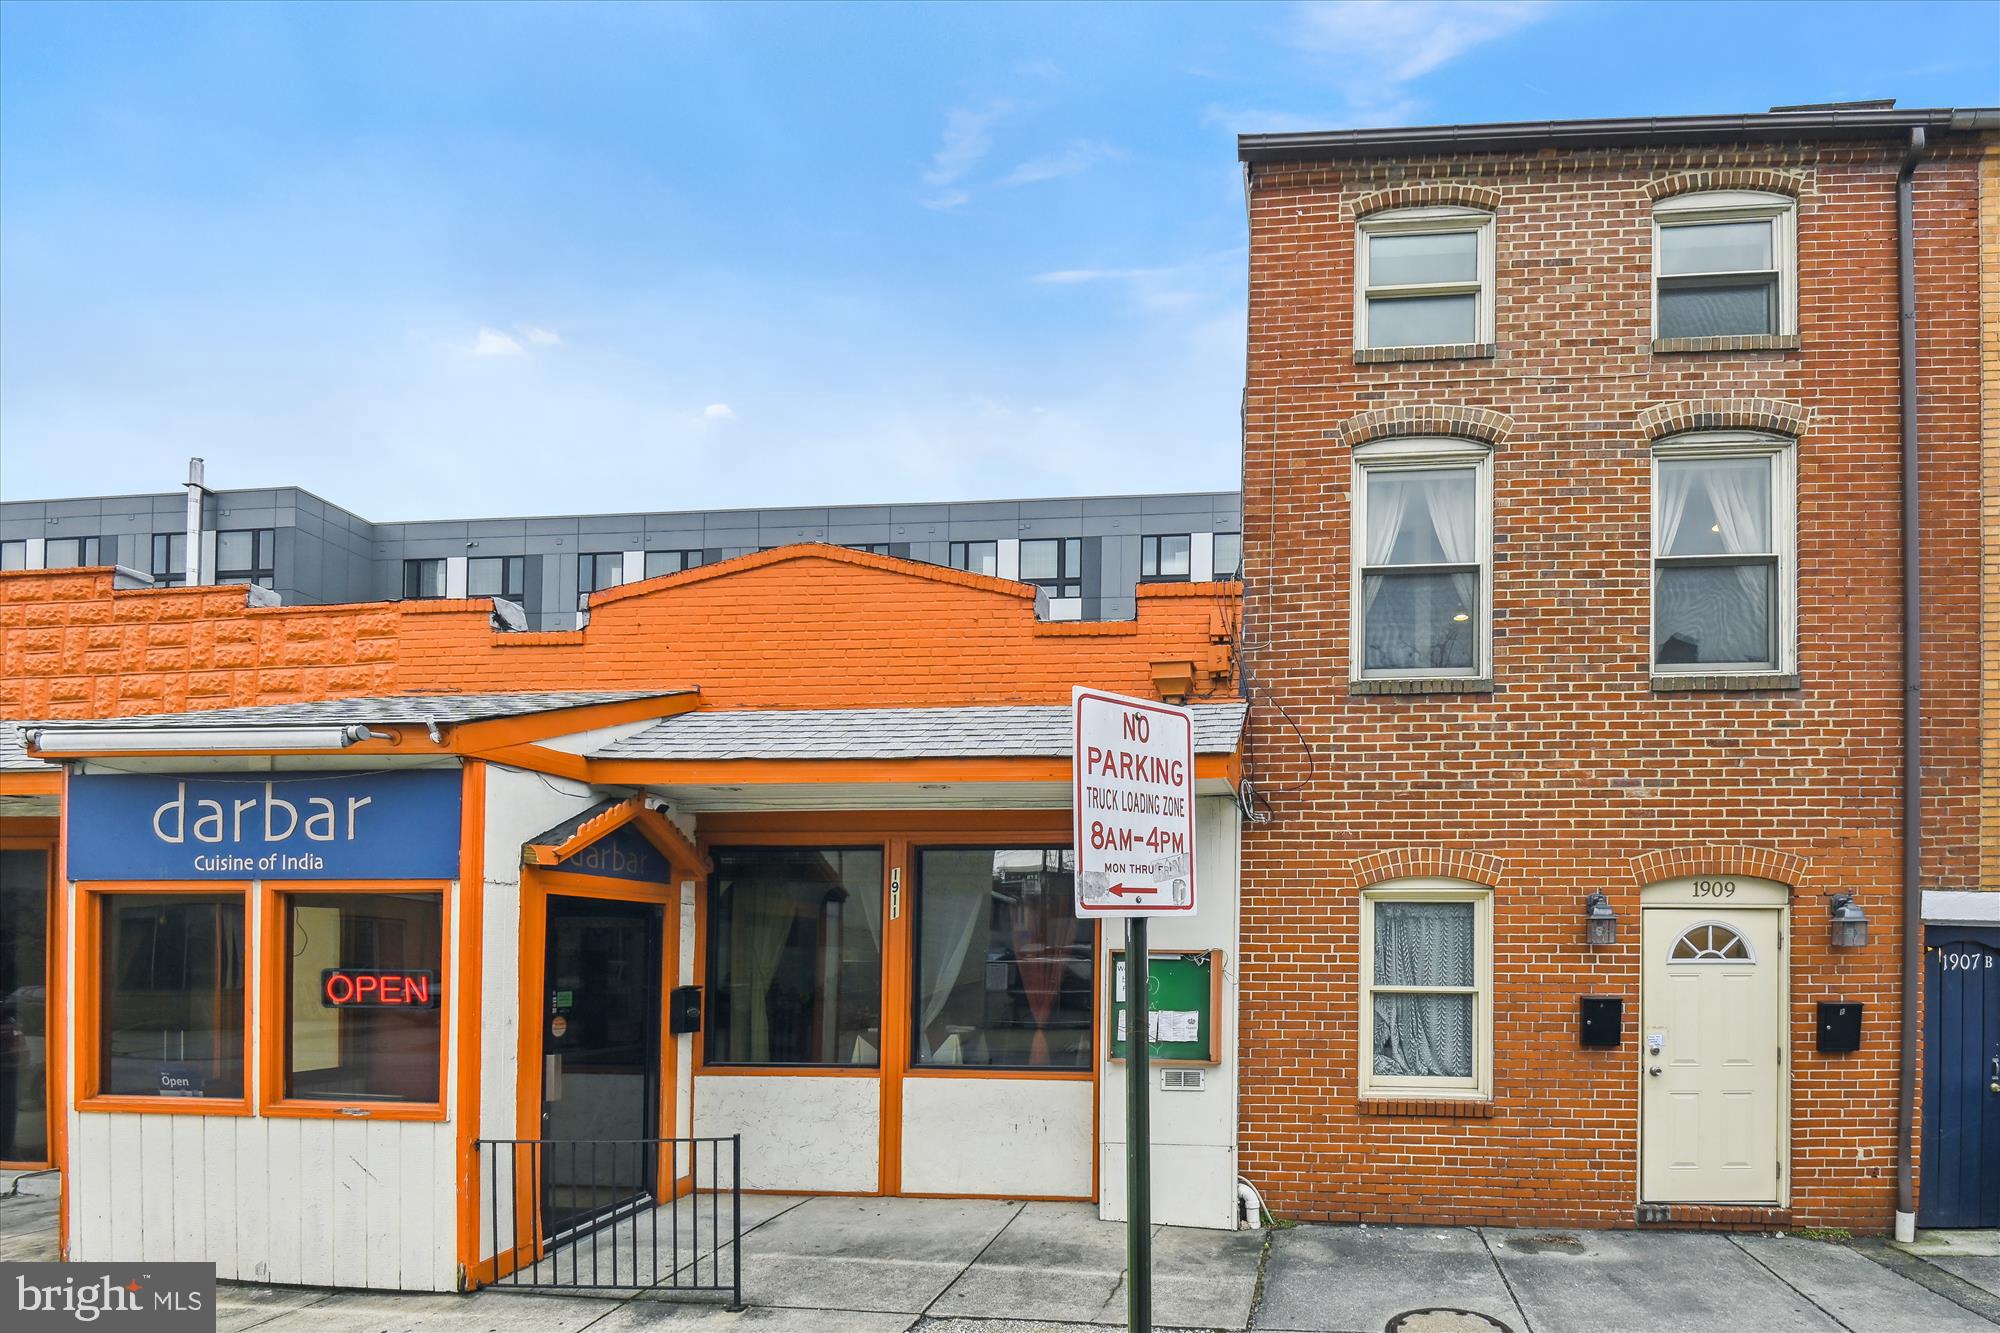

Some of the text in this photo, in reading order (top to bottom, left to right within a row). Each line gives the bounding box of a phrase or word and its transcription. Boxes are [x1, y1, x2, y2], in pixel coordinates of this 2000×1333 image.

[1123, 712, 1150, 743] NO
[1087, 746, 1184, 787] PARKING
[153, 781, 372, 843] darbar
[1086, 786, 1185, 818] TRUCK LOADING ZONE
[1091, 820, 1184, 854] 8AM-4PM
[194, 852, 324, 871] Cuisine of India
[1104, 863, 1126, 873] MON
[1130, 864, 1154, 875] THRU
[891, 869, 899, 919] 1911
[1692, 881, 1736, 898] 1909
[1943, 953, 1993, 971] 1907 B
[326, 974, 429, 1003] OPEN
[161, 1076, 189, 1088] Open
